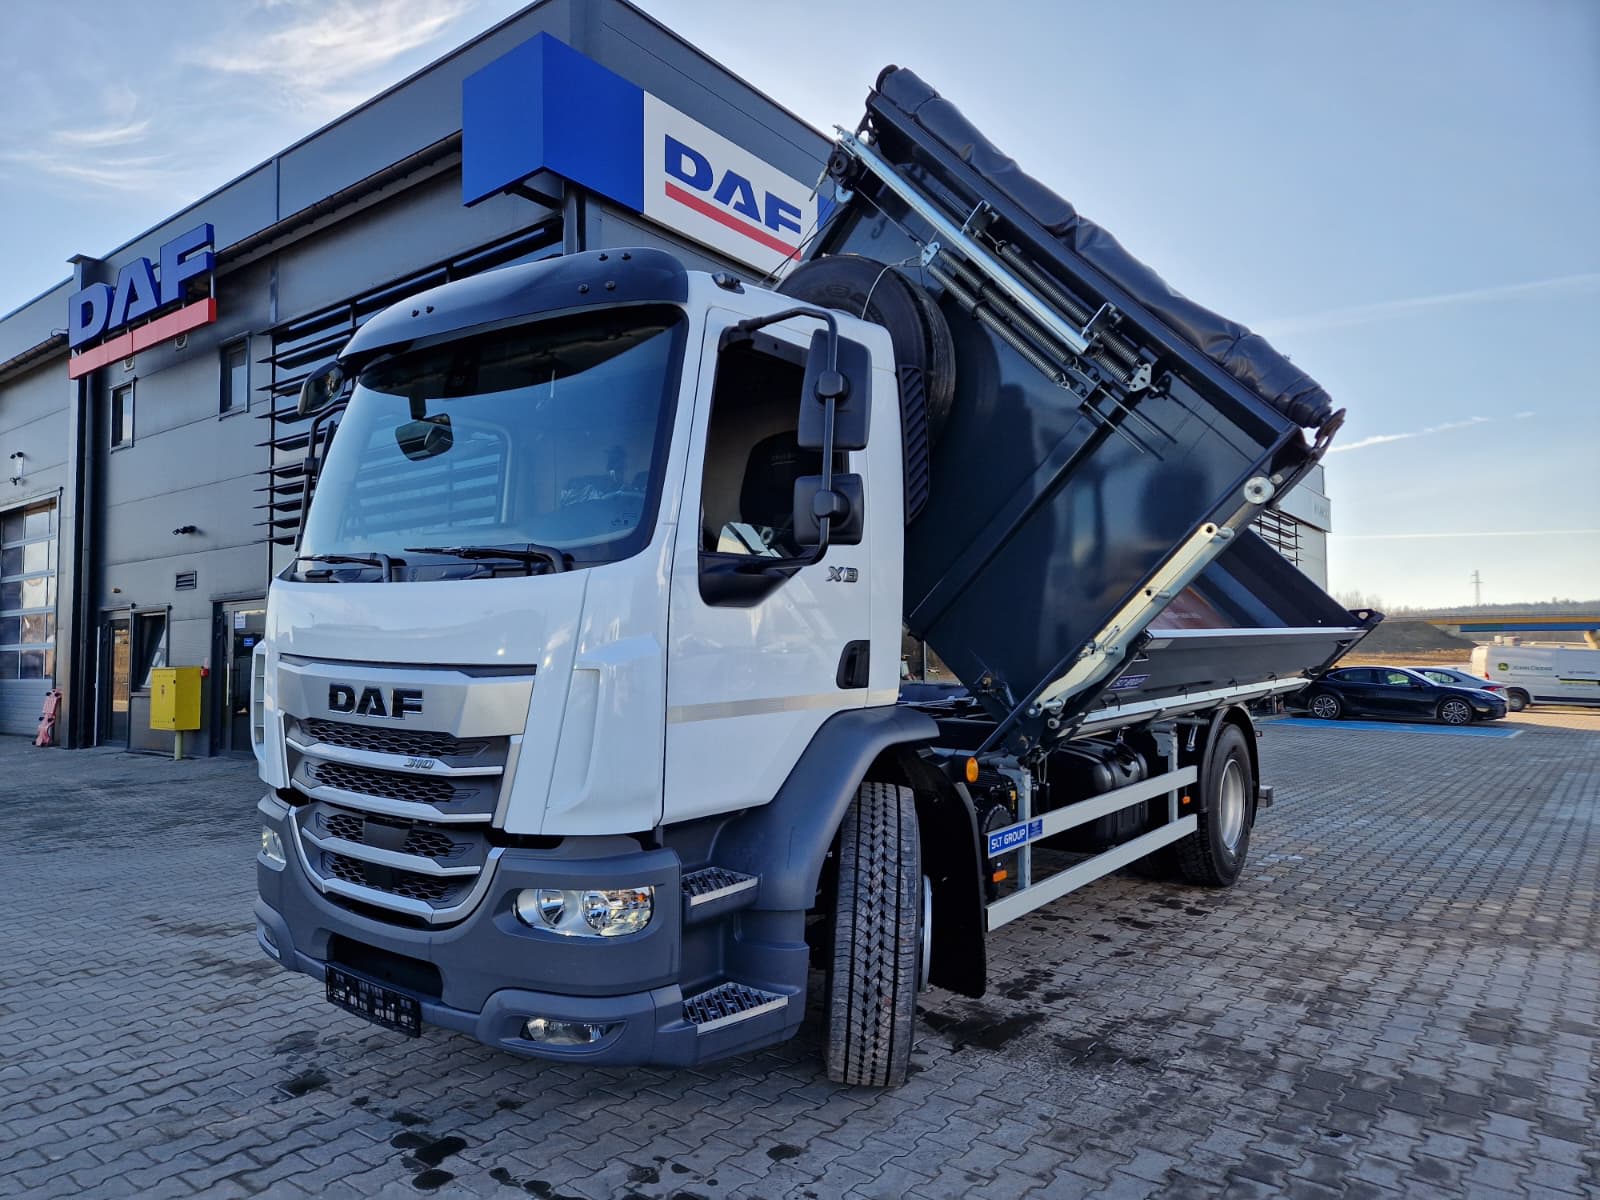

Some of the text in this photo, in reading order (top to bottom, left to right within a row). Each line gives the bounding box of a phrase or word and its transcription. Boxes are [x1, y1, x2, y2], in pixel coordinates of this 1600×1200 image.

[665, 133, 802, 234] DAF
[68, 223, 214, 349] DAF
[328, 683, 424, 720] DAF
[991, 836, 1003, 850] SLT
[1003, 828, 1026, 845] GROUP
